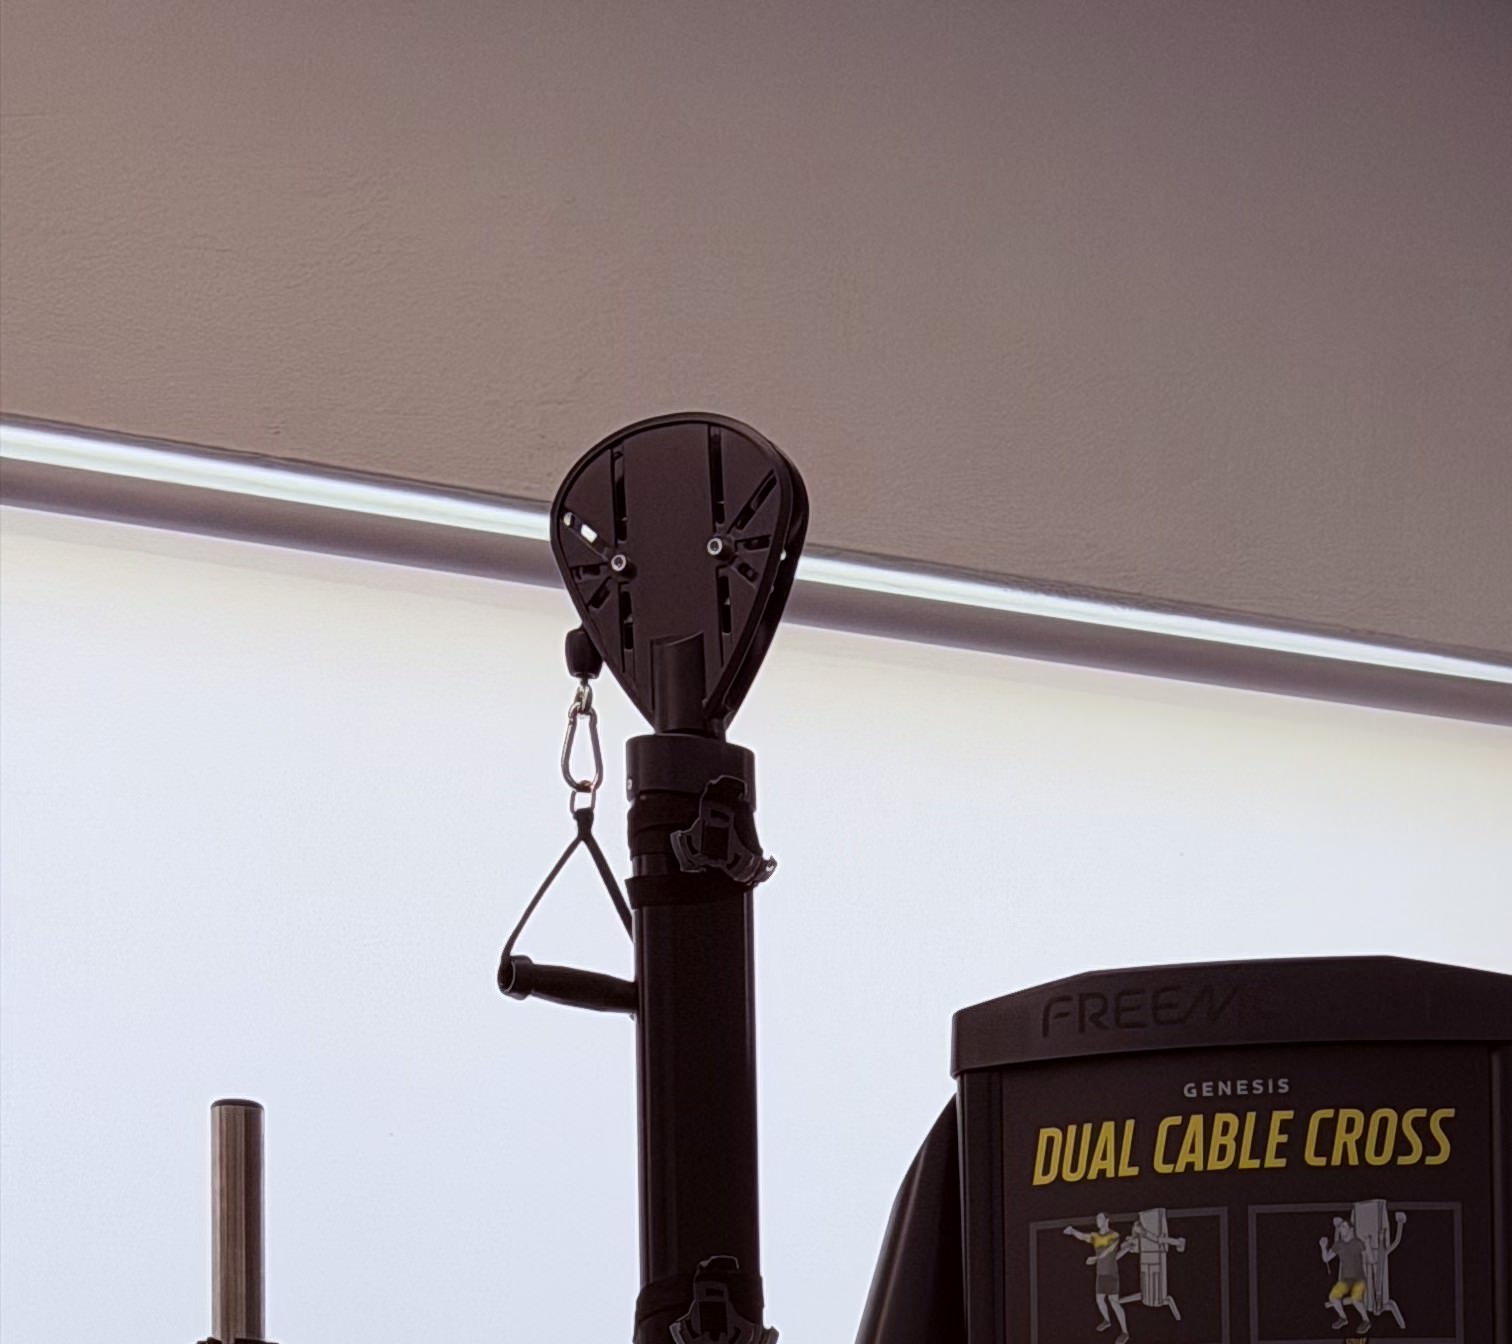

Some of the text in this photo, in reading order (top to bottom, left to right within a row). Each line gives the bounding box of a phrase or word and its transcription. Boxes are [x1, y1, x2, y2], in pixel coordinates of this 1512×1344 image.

[1183, 1077, 1291, 1099] GENESIS
[1031, 1107, 1456, 1186] DUAL CABLE CROSS
